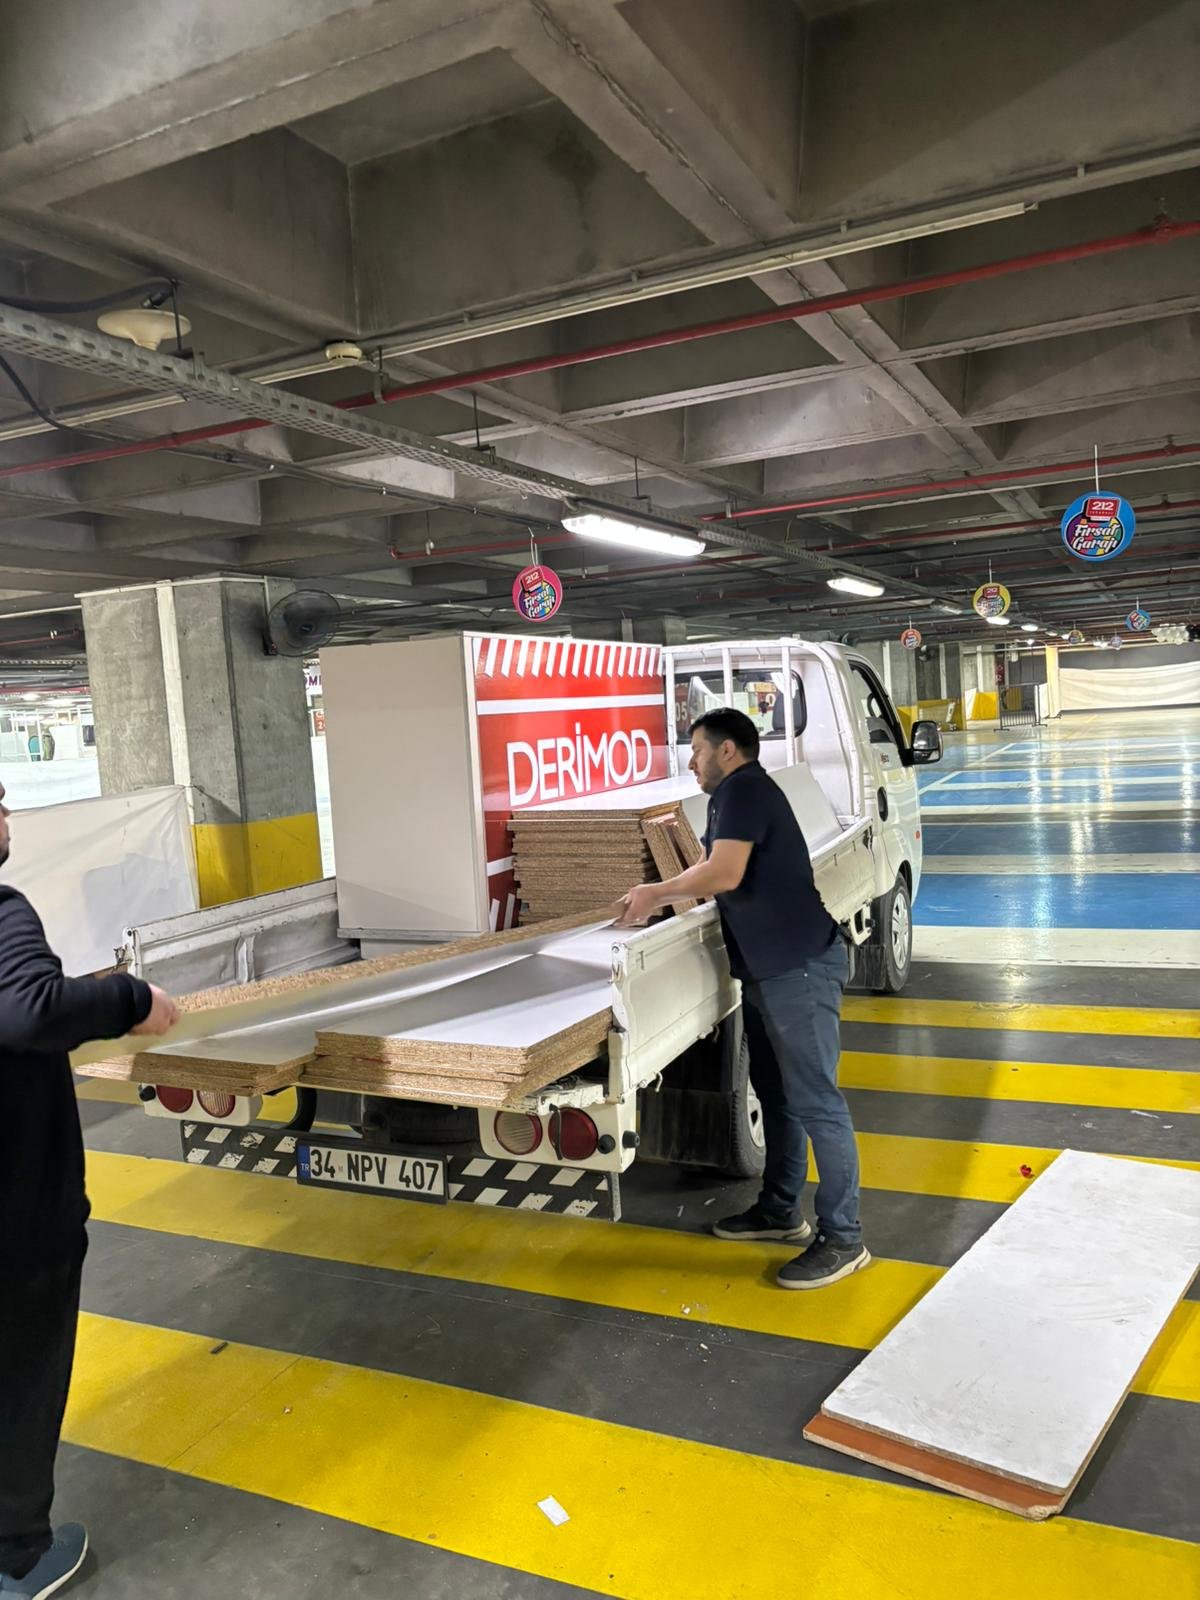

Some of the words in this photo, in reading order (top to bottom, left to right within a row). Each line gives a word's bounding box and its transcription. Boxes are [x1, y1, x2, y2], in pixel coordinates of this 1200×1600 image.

[1092, 501, 1115, 511] 212
[1075, 524, 1121, 537] Fırsat
[524, 571, 540, 585] 212
[506, 721, 653, 807] DERİMOD
[300, 1163, 310, 1171] TR
[310, 1149, 336, 1178] 34
[347, 1152, 388, 1185] NPV
[398, 1159, 439, 1191] 407
